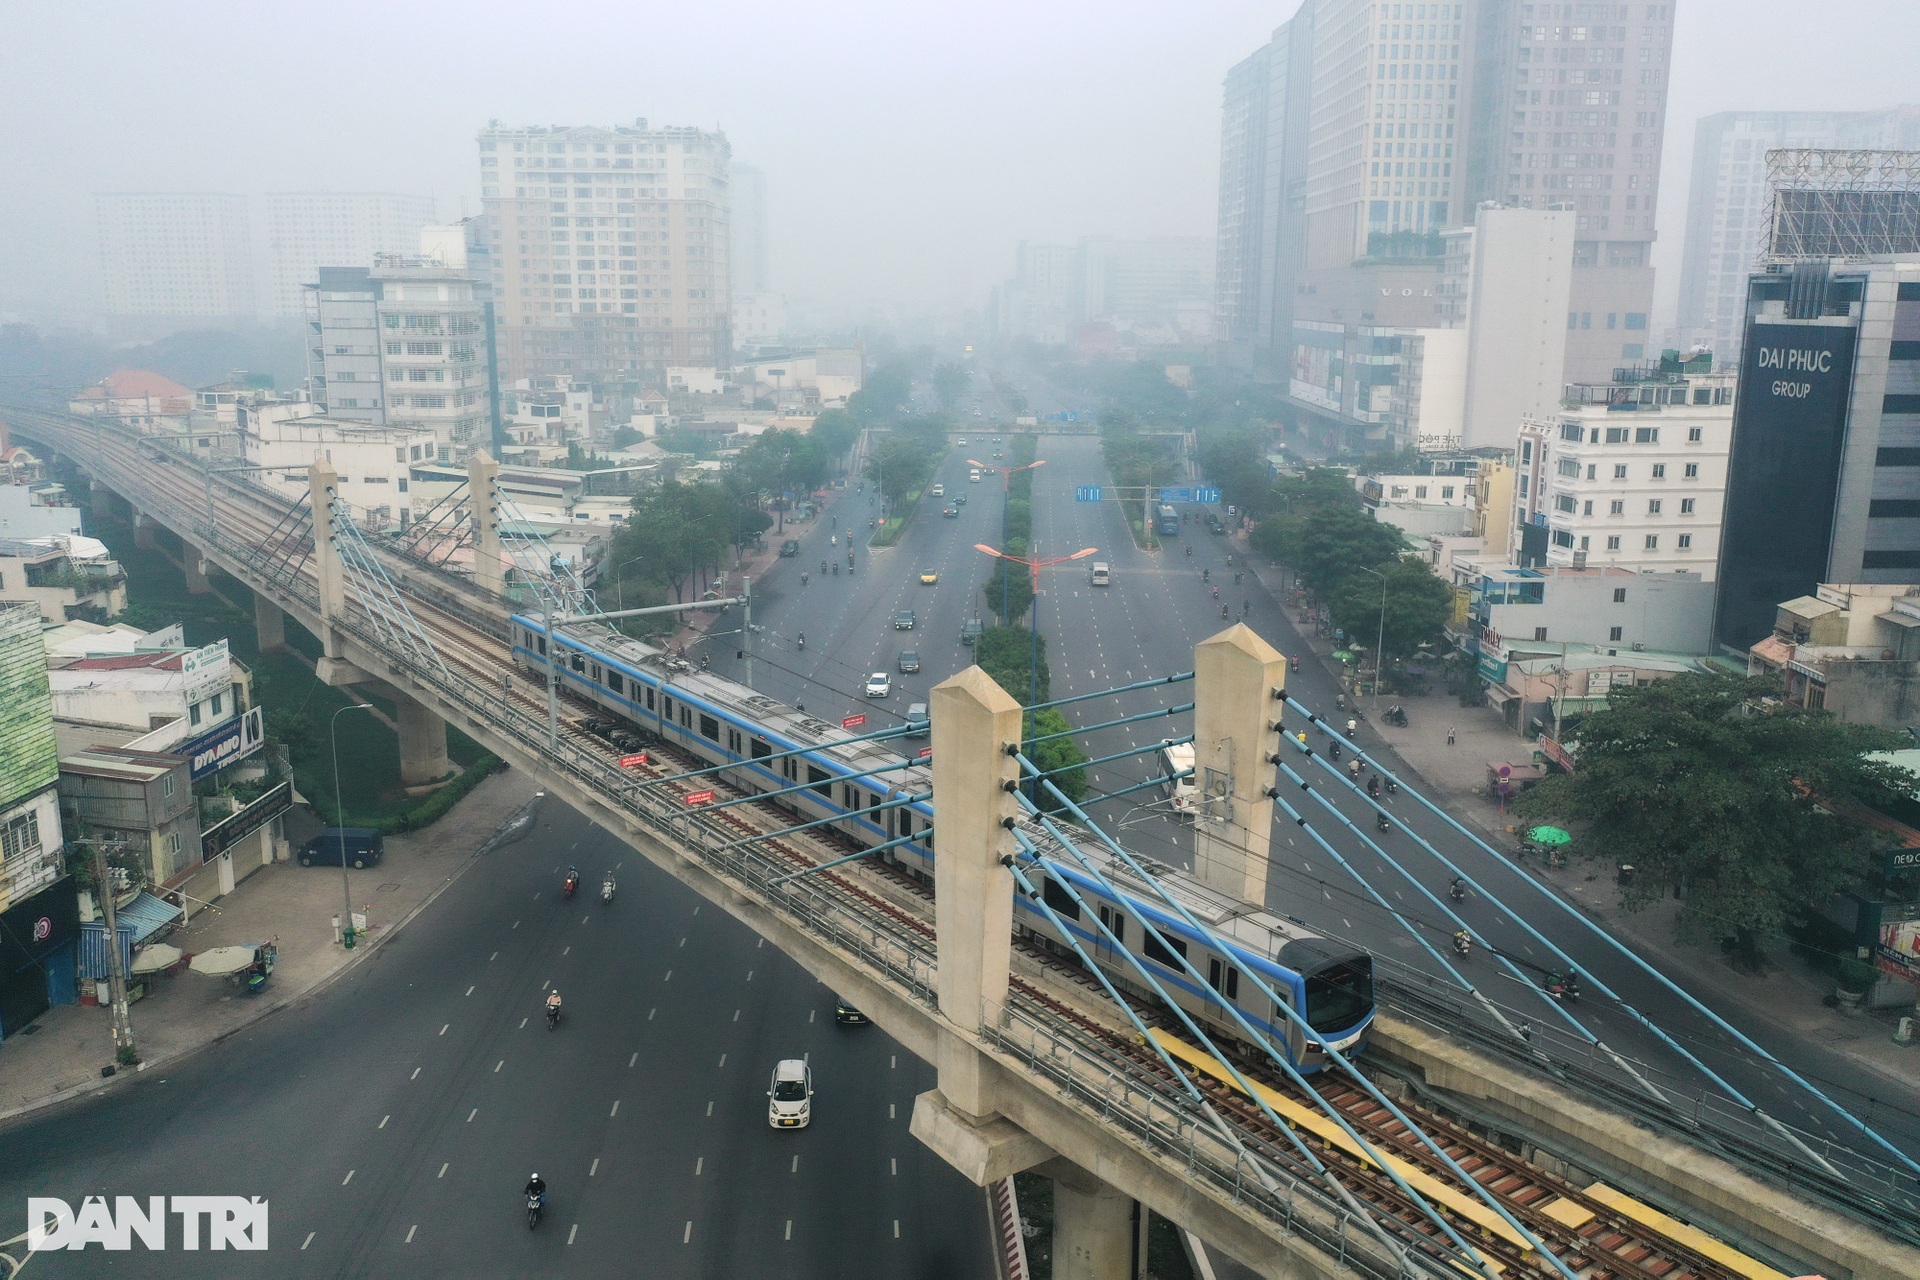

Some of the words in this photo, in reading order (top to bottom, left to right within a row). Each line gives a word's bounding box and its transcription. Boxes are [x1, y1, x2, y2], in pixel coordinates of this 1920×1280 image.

[1759, 347, 1784, 369] DAI
[1787, 349, 1832, 373] PHUC
[1772, 380, 1811, 399] GROUP
[194, 734, 240, 772] DYNAMO
